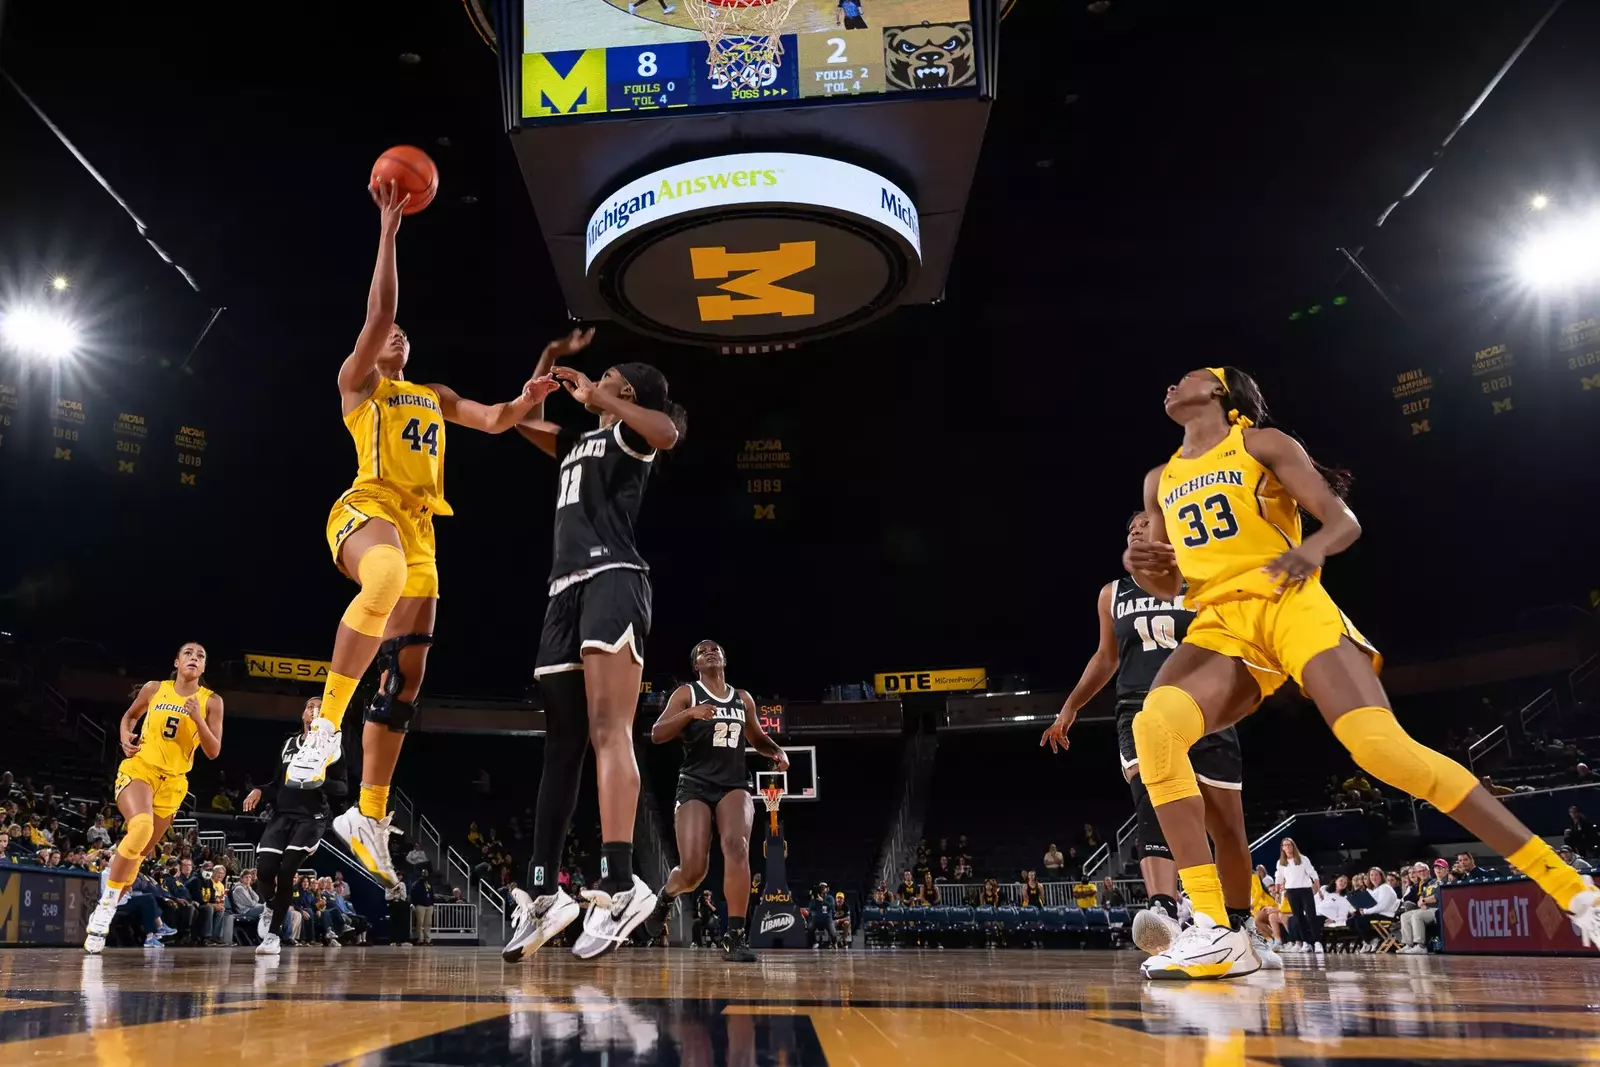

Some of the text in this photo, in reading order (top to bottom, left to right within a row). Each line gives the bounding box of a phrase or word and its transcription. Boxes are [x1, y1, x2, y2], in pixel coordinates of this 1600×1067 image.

[826, 38, 848, 64] 2
[637, 52, 658, 77] 8
[815, 68, 869, 82] FOULS 2
[624, 82, 675, 95] FOULS 0
[731, 89, 760, 100] POSS
[824, 81, 861, 93] TOL 4
[632, 94, 667, 106] TOL 4
[1402, 398, 1431, 415] 2017
[401, 417, 439, 456] 44
[747, 478, 783, 494] 1989
[1164, 470, 1244, 511] MICHIGAN
[753, 503, 777, 521] M
[1178, 493, 1240, 549] 33
[1117, 595, 1198, 619] OAKLAN
[1134, 615, 1179, 652] 10
[250, 660, 328, 677] NISSA
[884, 674, 931, 691] DTE
[761, 705, 783, 716] 5:49
[163, 716, 180, 739] 5
[712, 722, 742, 749] 23
[24, 890, 32, 907] 8
[68, 893, 75, 909] 2
[765, 894, 790, 902] UMCU
[42, 904, 59, 917] 5:49
[760, 916, 792, 935] LIBMAN
